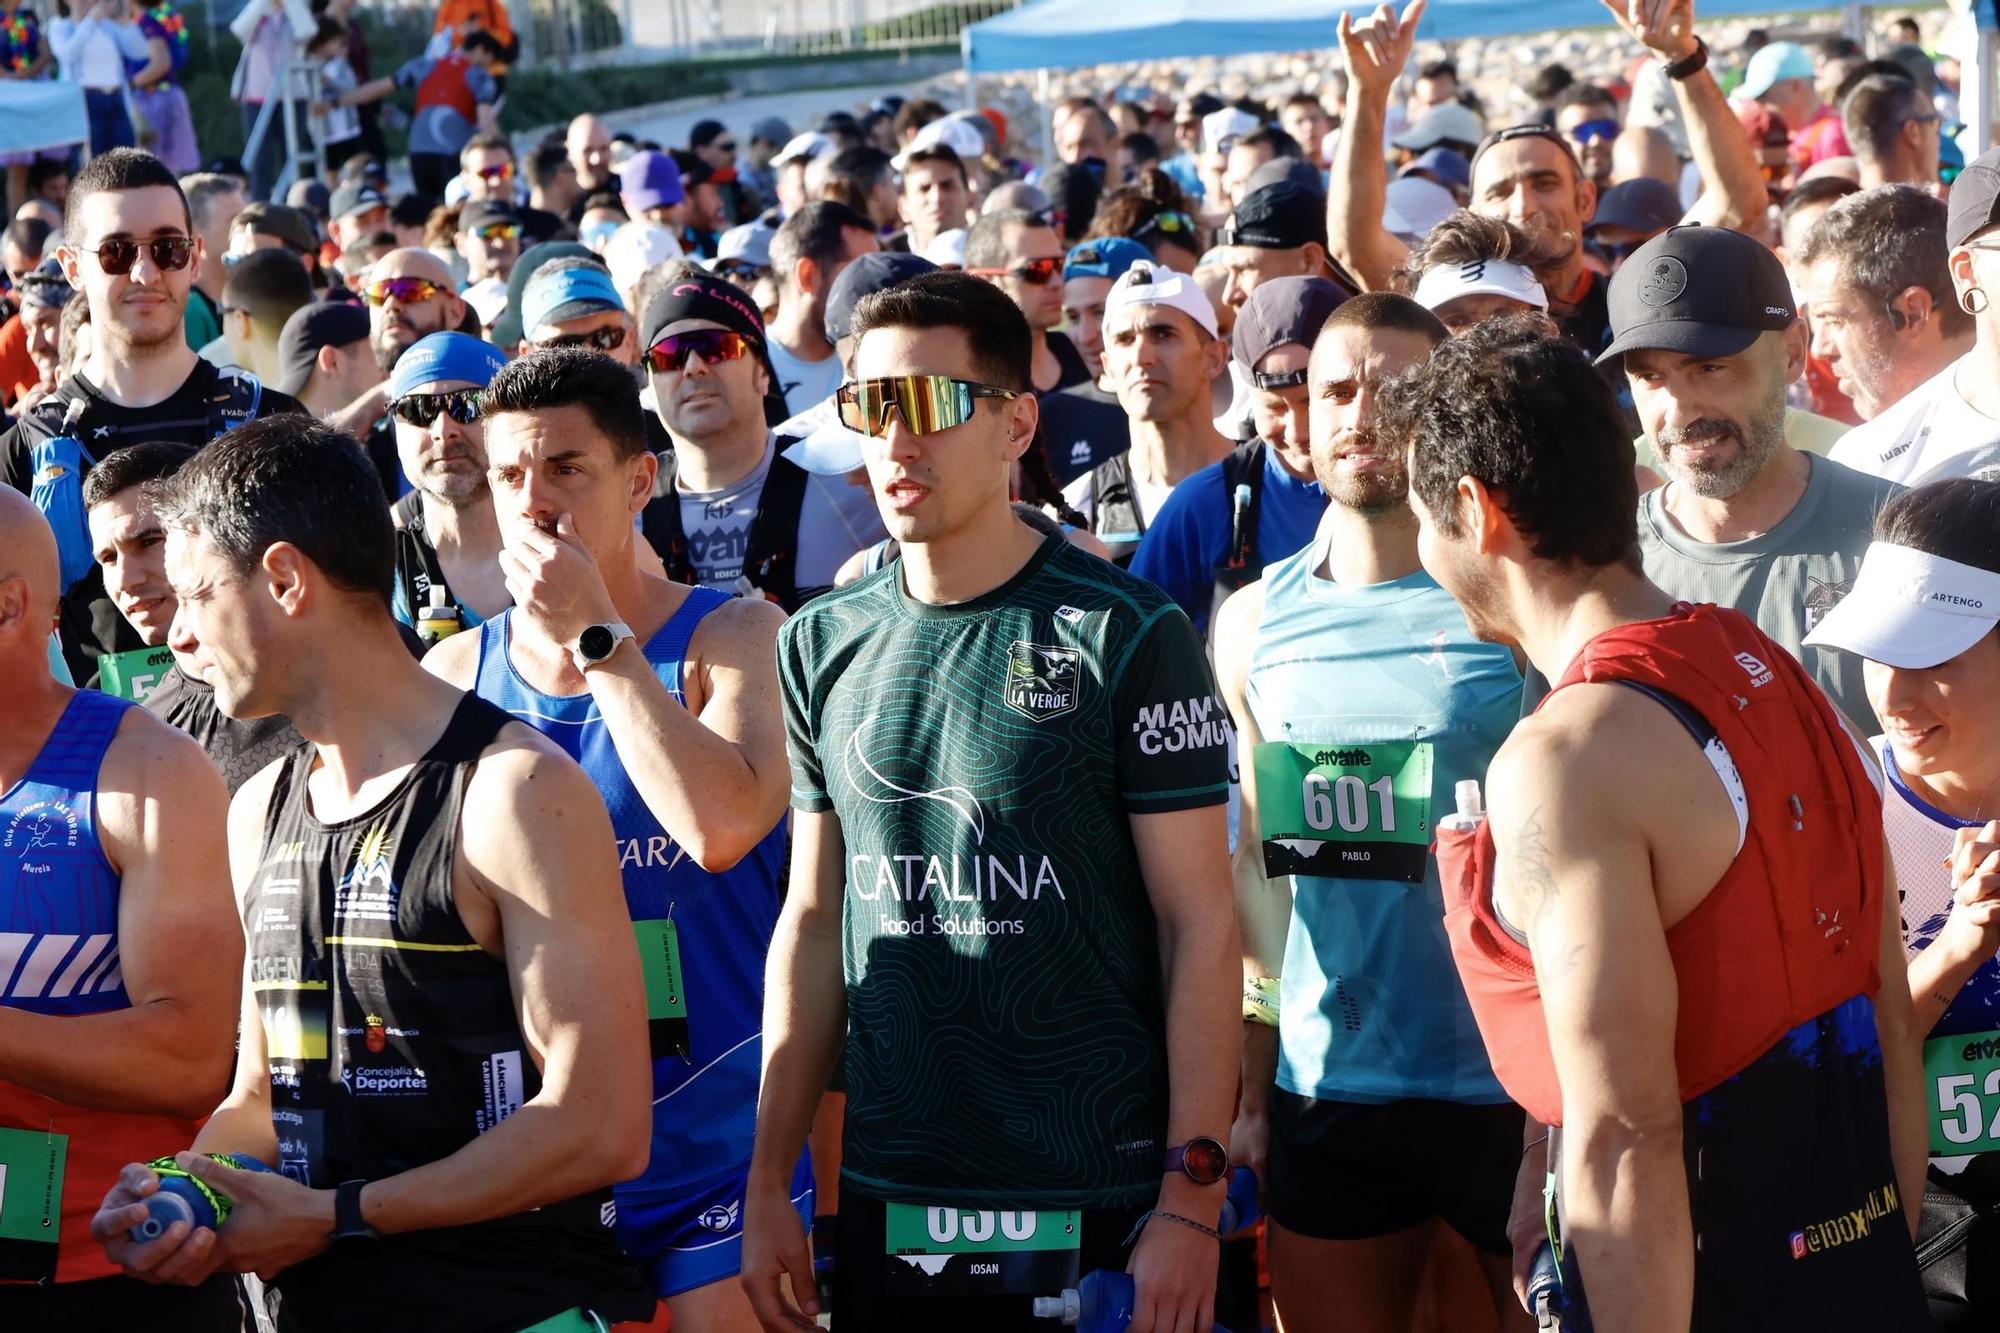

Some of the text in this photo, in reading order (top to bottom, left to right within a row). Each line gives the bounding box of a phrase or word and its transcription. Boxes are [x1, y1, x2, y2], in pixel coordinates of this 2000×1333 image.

[1765, 306, 1785, 316] CRAFT
[1931, 591, 1983, 609] ARTENGO
[1011, 688, 1070, 709] LA VERDE
[1302, 772, 1396, 833] 601
[54, 800, 70, 815] LAS
[65, 812, 78, 847] TORRES
[1341, 851, 1371, 861] PABLO
[22, 862, 51, 873] Murcia
[851, 854, 1066, 901] CATALINA
[880, 913, 1024, 936] Food Solutions
[355, 1076, 428, 1091] Deportes
[970, 1263, 999, 1275] JOSAN
